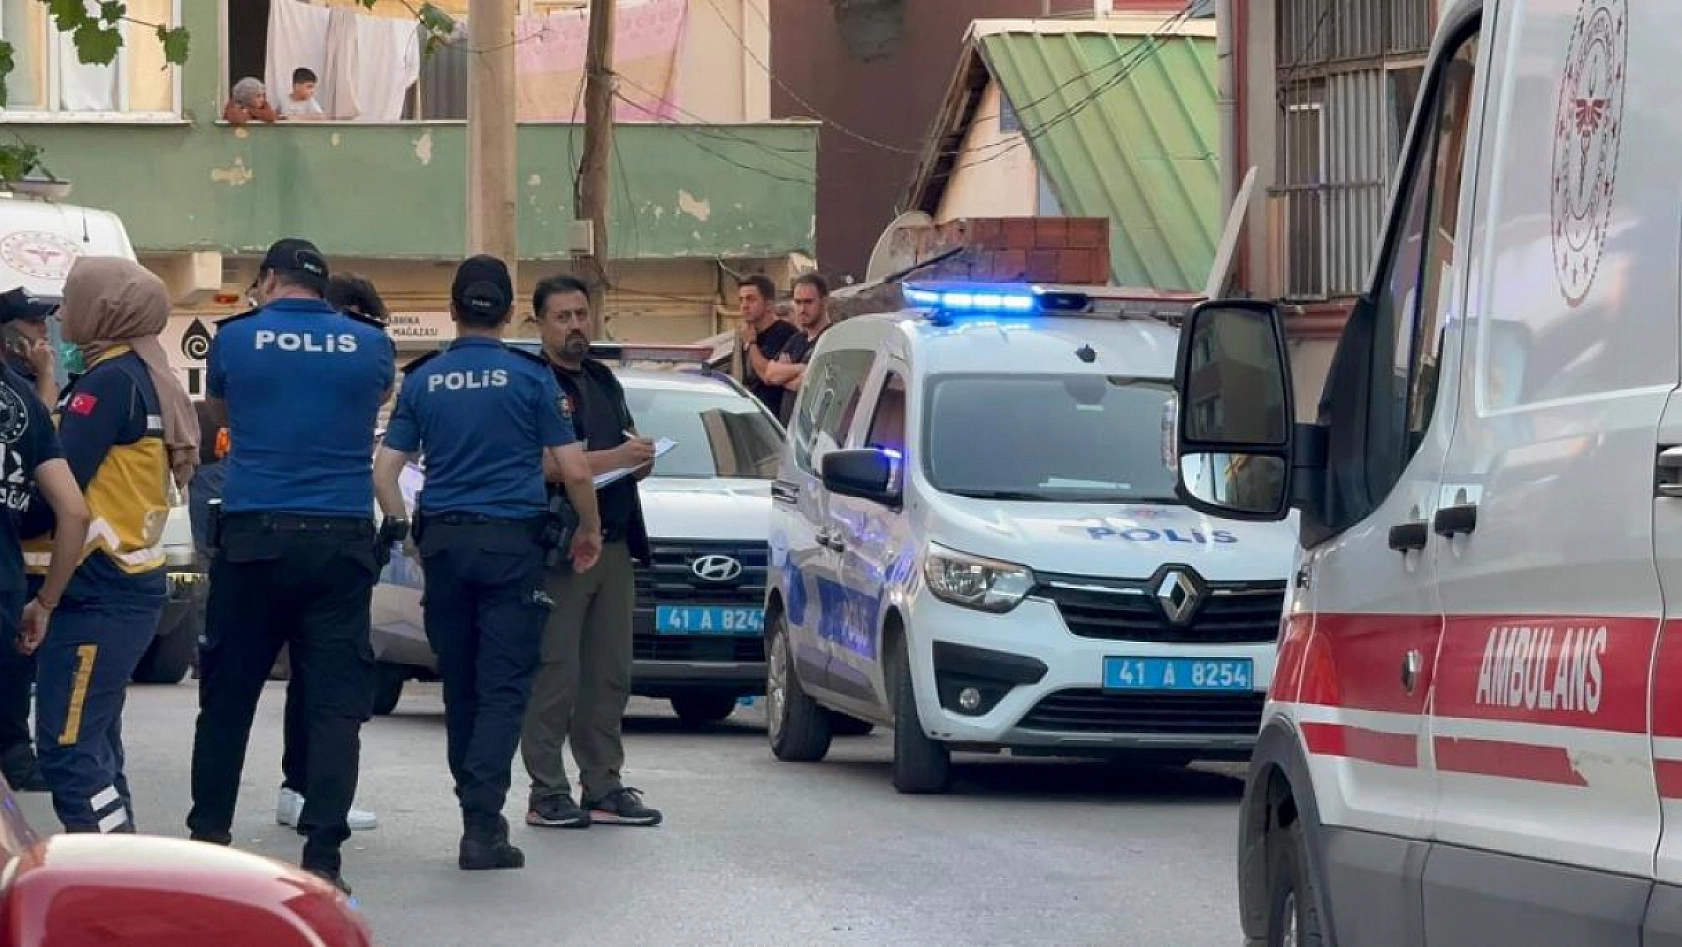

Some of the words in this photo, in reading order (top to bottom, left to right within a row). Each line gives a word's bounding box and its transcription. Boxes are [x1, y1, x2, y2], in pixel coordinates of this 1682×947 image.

[669, 609, 689, 629] 41
[701, 609, 712, 629] A
[1119, 659, 1146, 685] 41
[1162, 661, 1176, 686] A
[1191, 662, 1248, 687] 8254
[1475, 625, 1607, 715] AMBULANS
